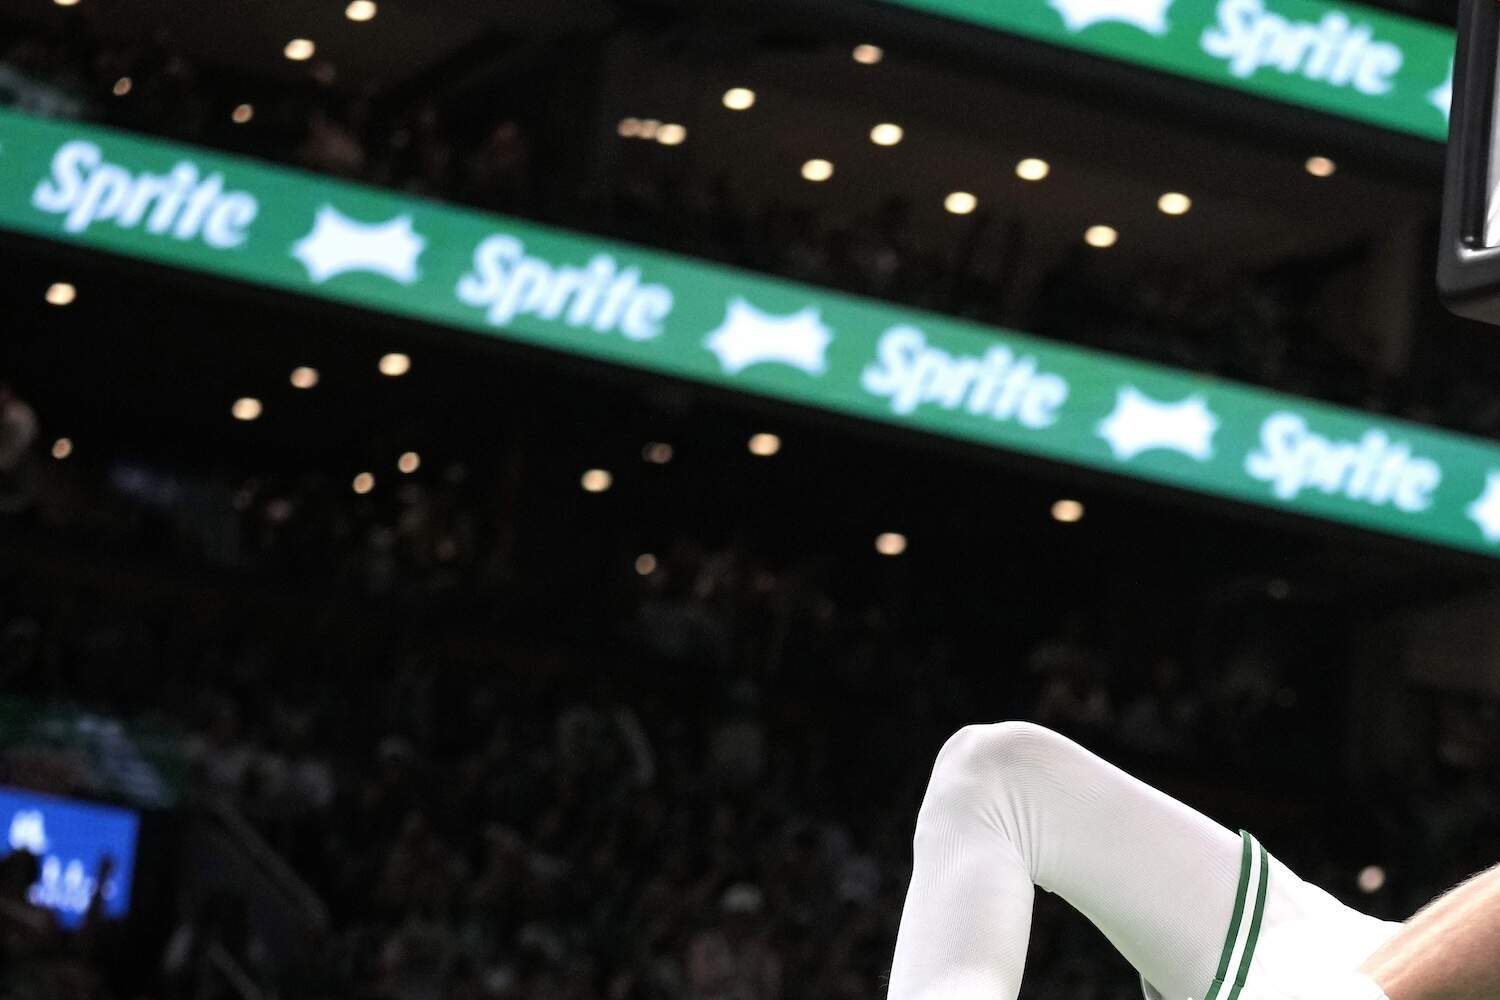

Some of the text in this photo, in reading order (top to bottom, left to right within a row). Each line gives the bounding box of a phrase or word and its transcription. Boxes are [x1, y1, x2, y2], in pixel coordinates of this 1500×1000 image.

[1200, 0, 1402, 95] Sprite
[33, 141, 257, 249] Sprite
[455, 235, 675, 342] Sprite
[859, 323, 1070, 430] Sprite
[1243, 411, 1442, 512] Sprite
